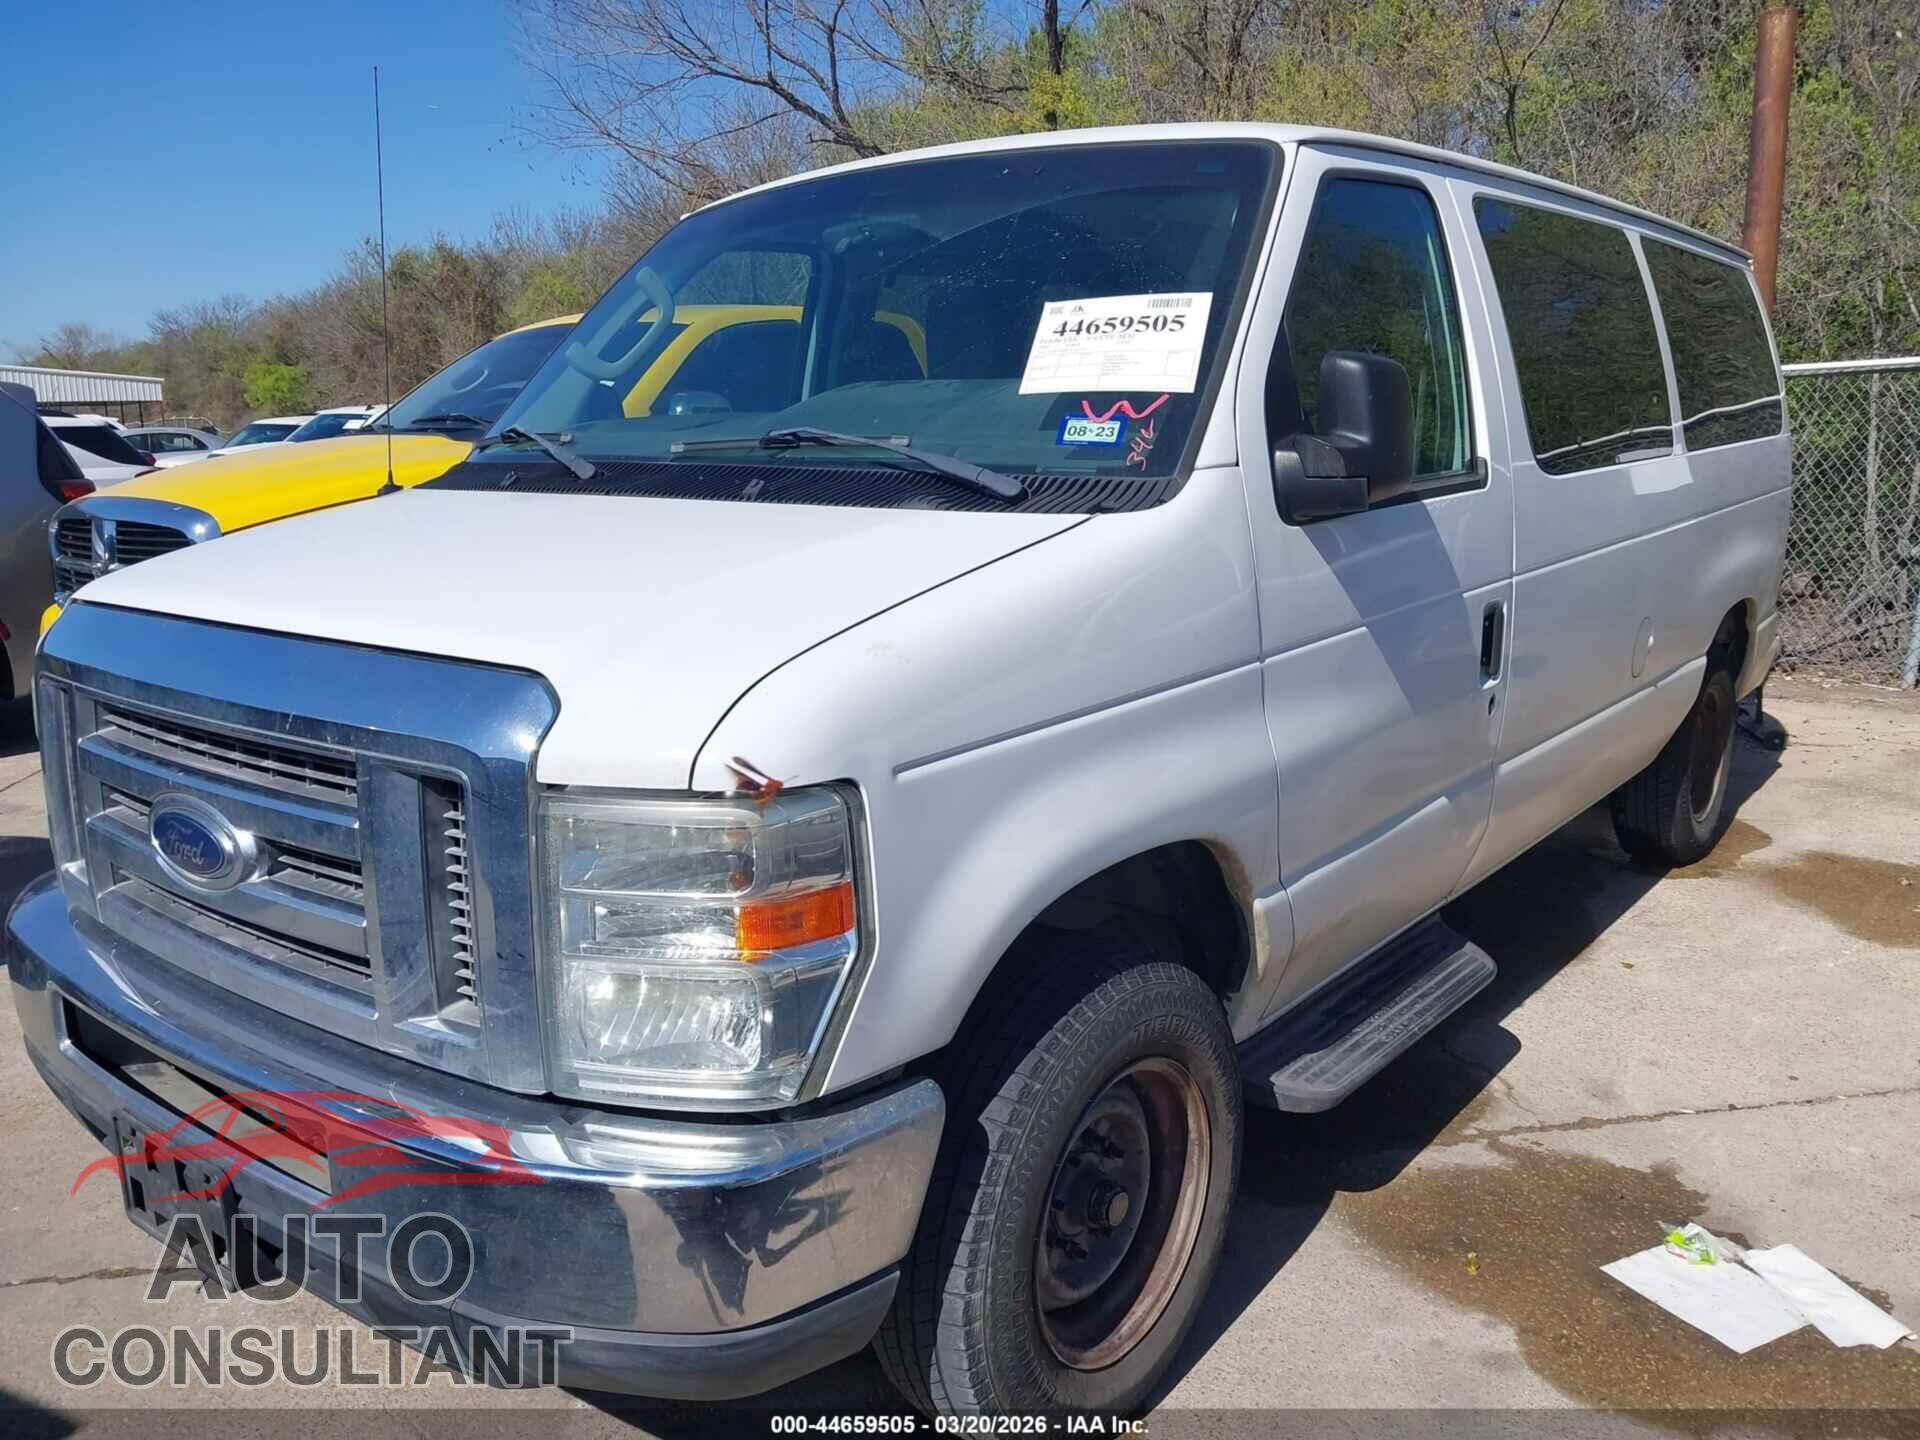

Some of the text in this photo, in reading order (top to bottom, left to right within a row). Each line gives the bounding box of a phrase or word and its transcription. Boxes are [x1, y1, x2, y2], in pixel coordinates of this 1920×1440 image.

[1052, 314, 1187, 337] 44659505
[1067, 425, 1115, 438] 08 23
